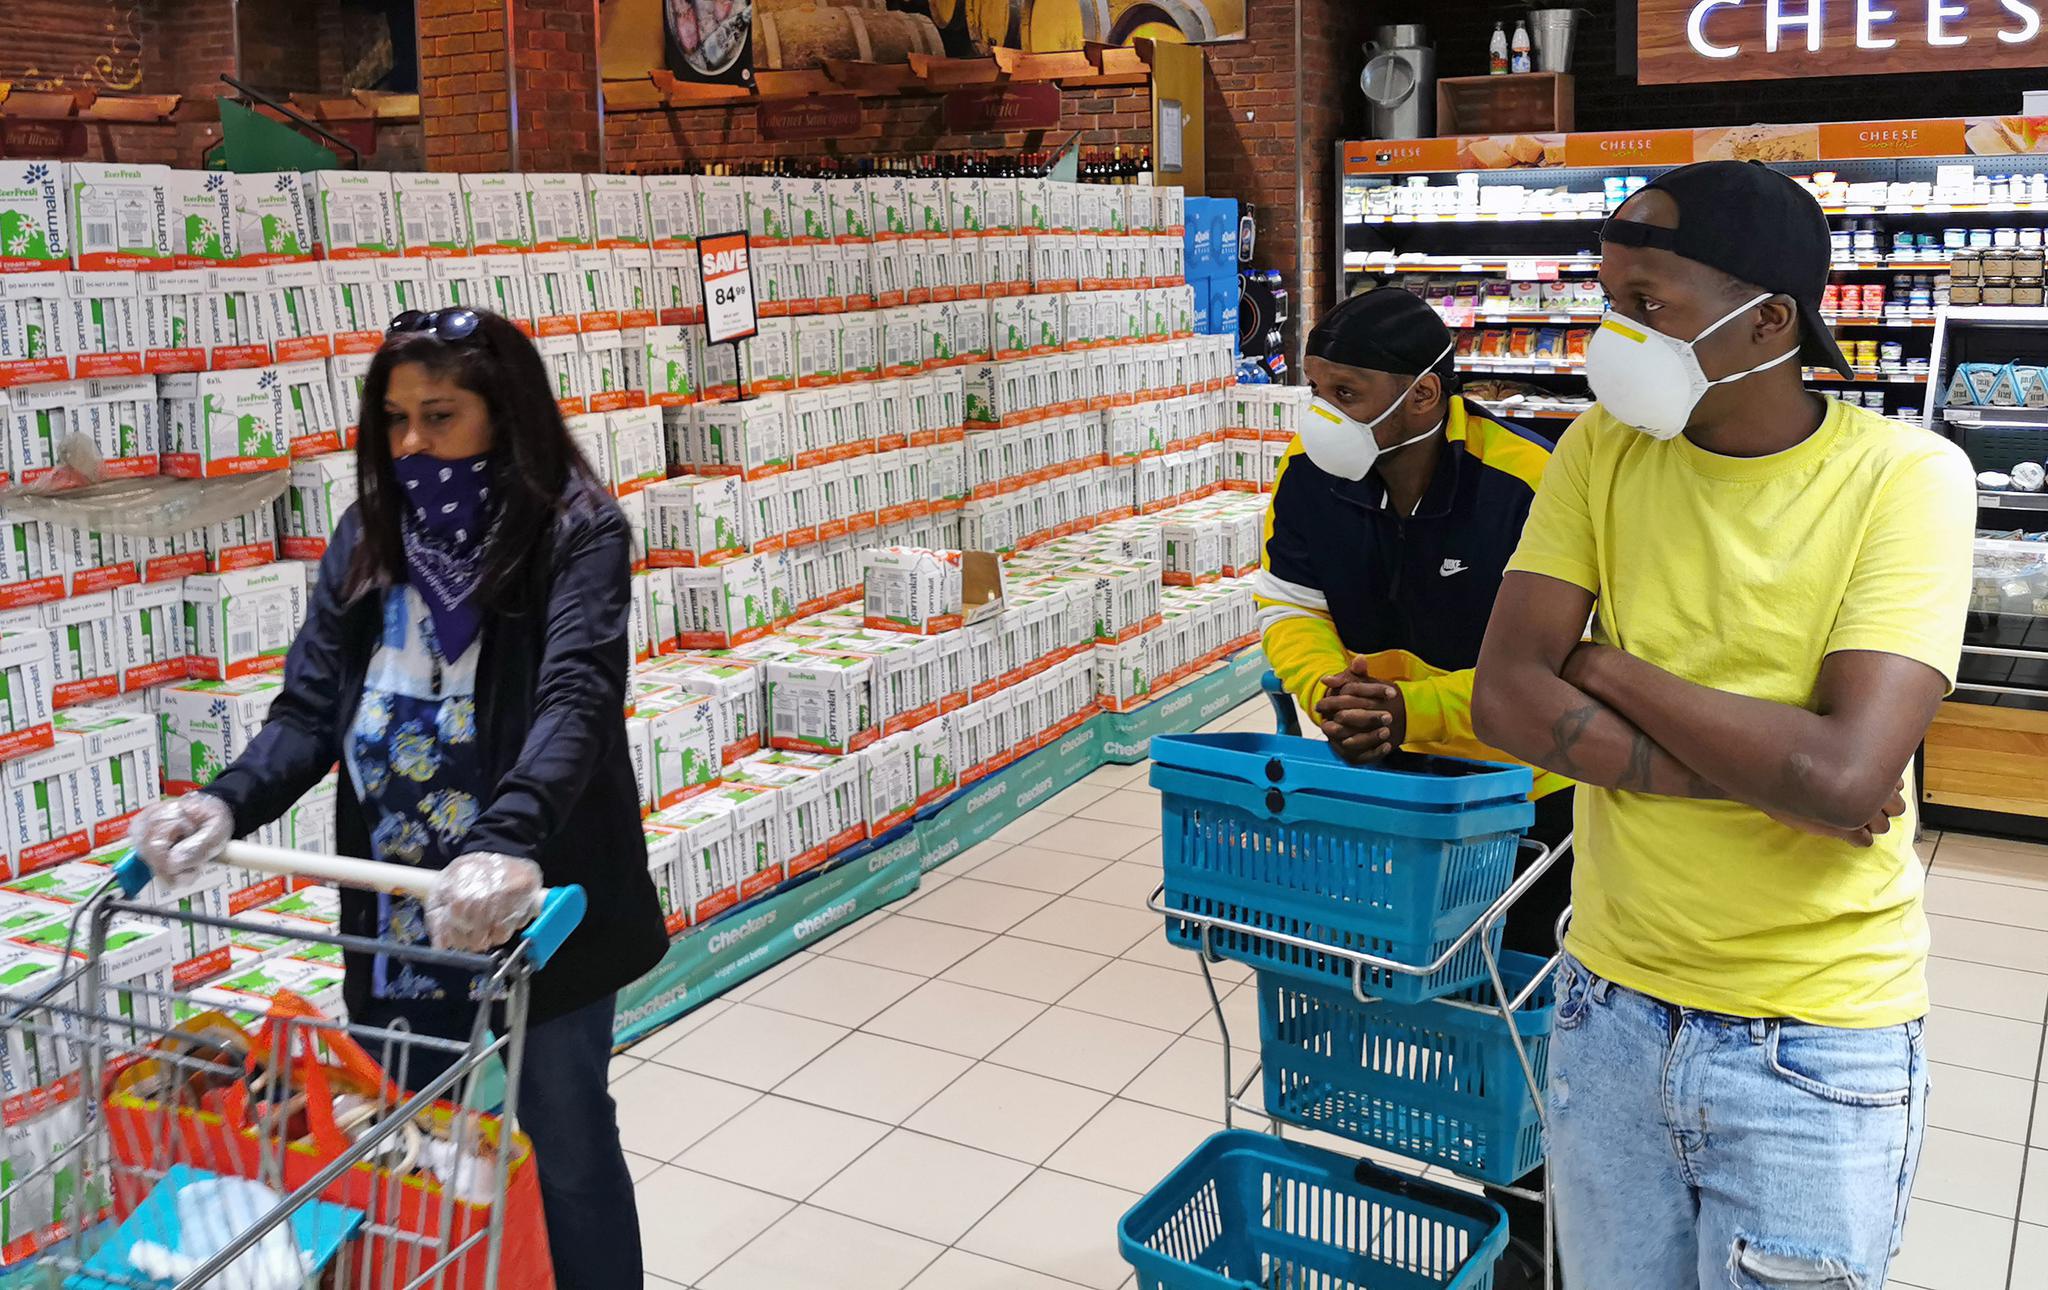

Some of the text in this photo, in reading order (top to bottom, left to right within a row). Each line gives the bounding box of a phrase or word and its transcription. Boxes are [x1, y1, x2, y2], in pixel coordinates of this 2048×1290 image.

[983, 102, 1020, 119] Merlot
[1859, 129, 1918, 141] CHEESE
[1600, 139, 1651, 150] CHEESE
[104, 170, 142, 179] EverFresh
[42, 178, 64, 254] parmalat
[153, 186, 170, 252] parmalat
[218, 187, 234, 256] parmalat
[289, 186, 309, 250] parmalat
[379, 192, 394, 248] parmalat
[448, 192, 466, 248] parmalat
[702, 248, 749, 276] SAVE
[74, 300, 88, 350] parmalat
[209, 297, 222, 343] parmalat
[269, 292, 285, 336] parmalat
[237, 394, 269, 402] EverFresh
[272, 384, 287, 451] parmalat
[17, 414, 34, 466] parmalat
[1444, 558, 1461, 570] NIKE
[910, 572, 921, 625] parmalat
[1104, 588, 1113, 635] parmalat
[49, 629, 63, 680] parmalat
[29, 664, 46, 718] parmalat
[827, 689, 840, 744] parmalat
[706, 714, 718, 774] parmalat
[1060, 728, 1094, 756] Checkers
[13, 786, 30, 842] parmalat
[66, 770, 81, 823] parmalat
[88, 764, 103, 815] parmalat
[967, 781, 1007, 814] Checkers
[1017, 776, 1053, 807] Checkers
[708, 910, 777, 953] Checkers
[793, 898, 857, 940] Checkers
[612, 983, 687, 1032] Checkers
